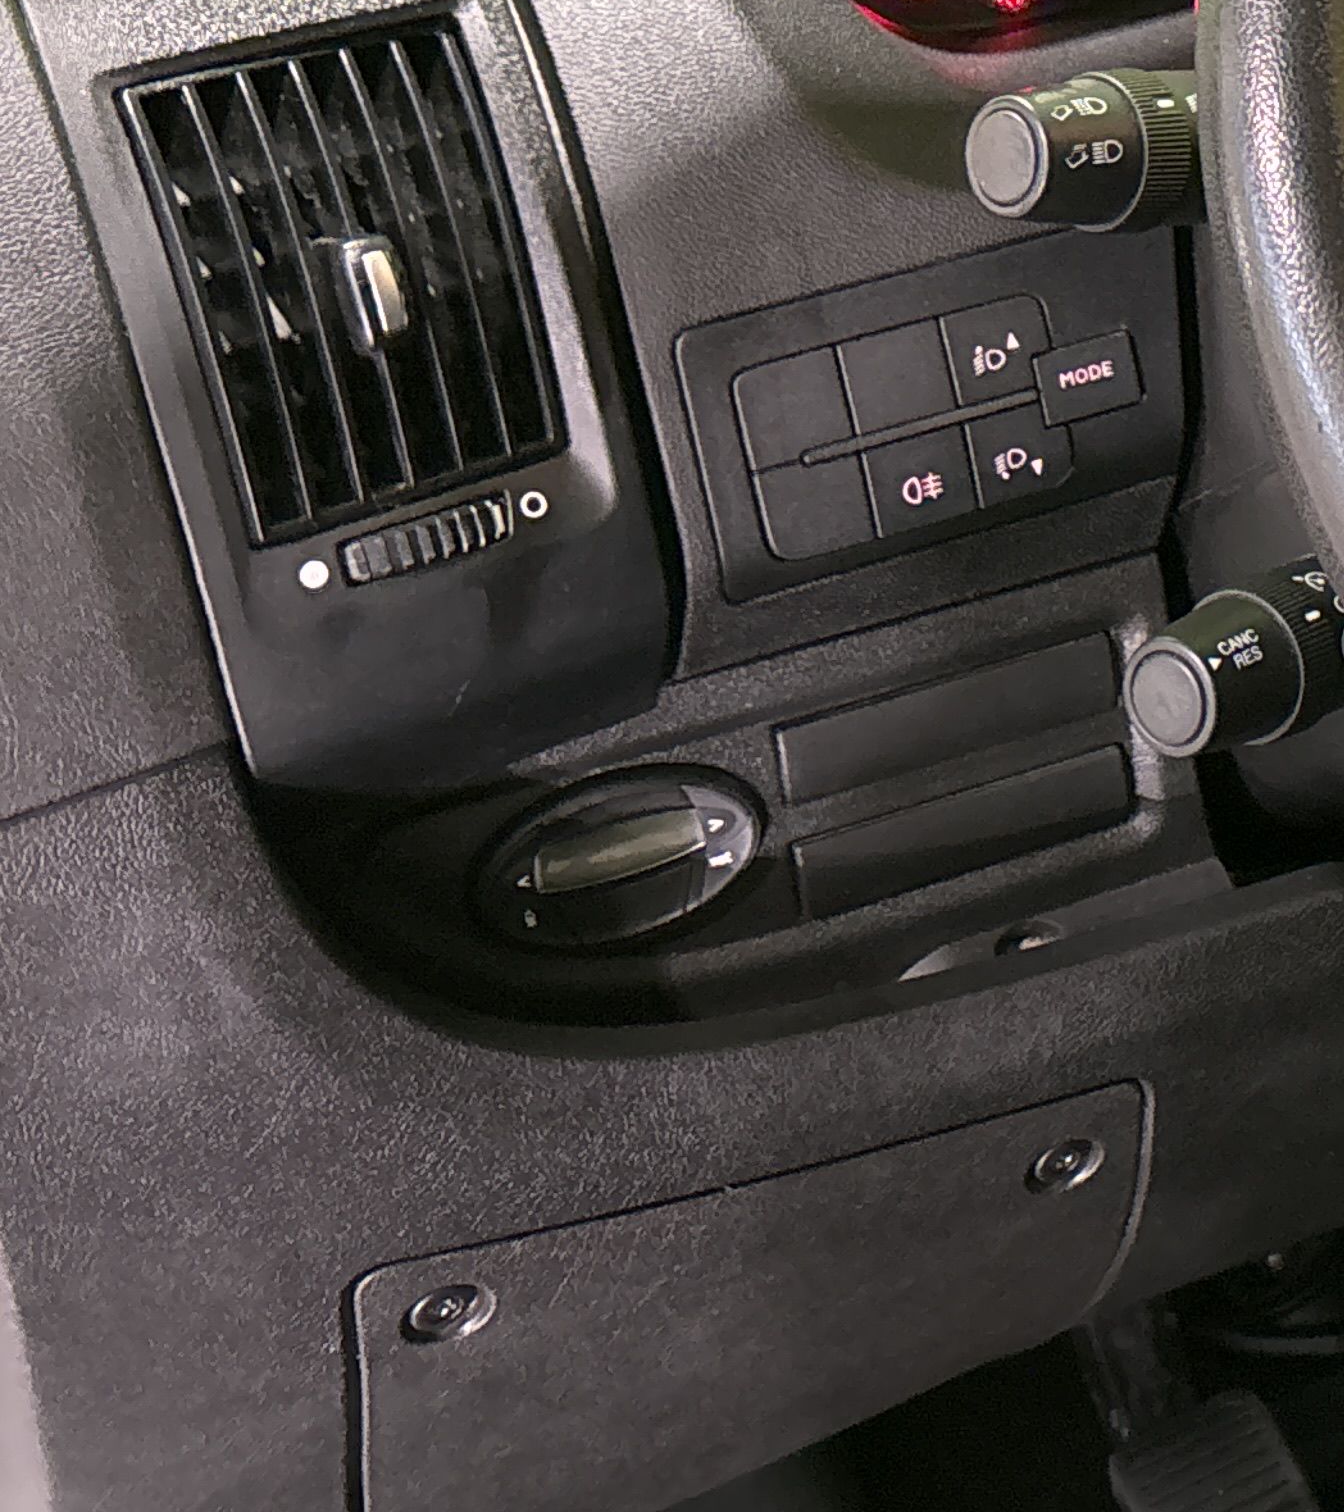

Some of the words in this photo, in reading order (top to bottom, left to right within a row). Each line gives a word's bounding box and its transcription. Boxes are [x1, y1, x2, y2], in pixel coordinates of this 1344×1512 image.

[1058, 359, 1115, 389] MODE
[1217, 628, 1260, 656] CANC
[1232, 645, 1264, 671] RES
